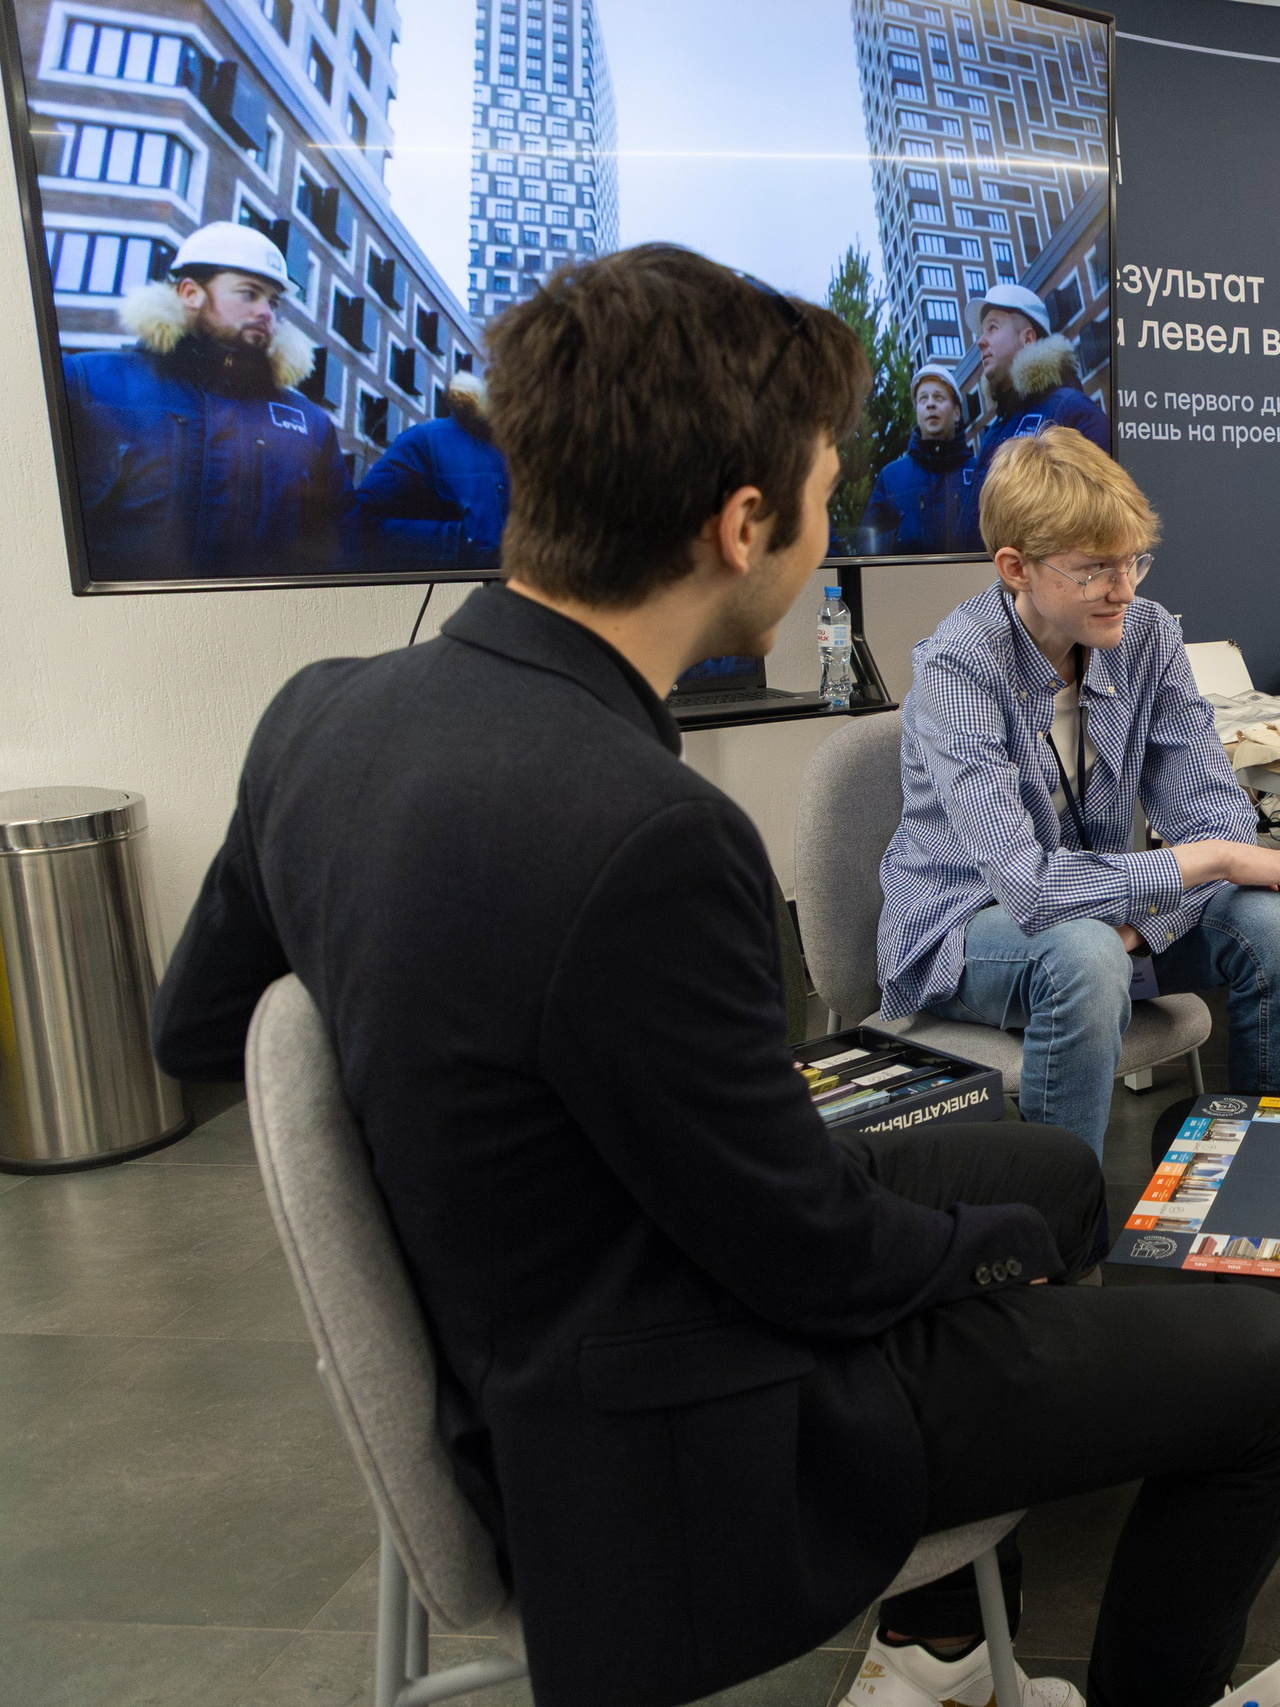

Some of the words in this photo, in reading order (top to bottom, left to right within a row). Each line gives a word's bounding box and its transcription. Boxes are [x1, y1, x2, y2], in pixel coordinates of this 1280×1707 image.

[1116, 264, 1265, 307] зультат
[1138, 320, 1250, 354] левел
[1144, 390, 1158, 409] с
[1164, 391, 1255, 417] первого
[1188, 423, 1216, 442] на
[859, 1086, 990, 1133] УВЛЕКАТЕЛЬНА
